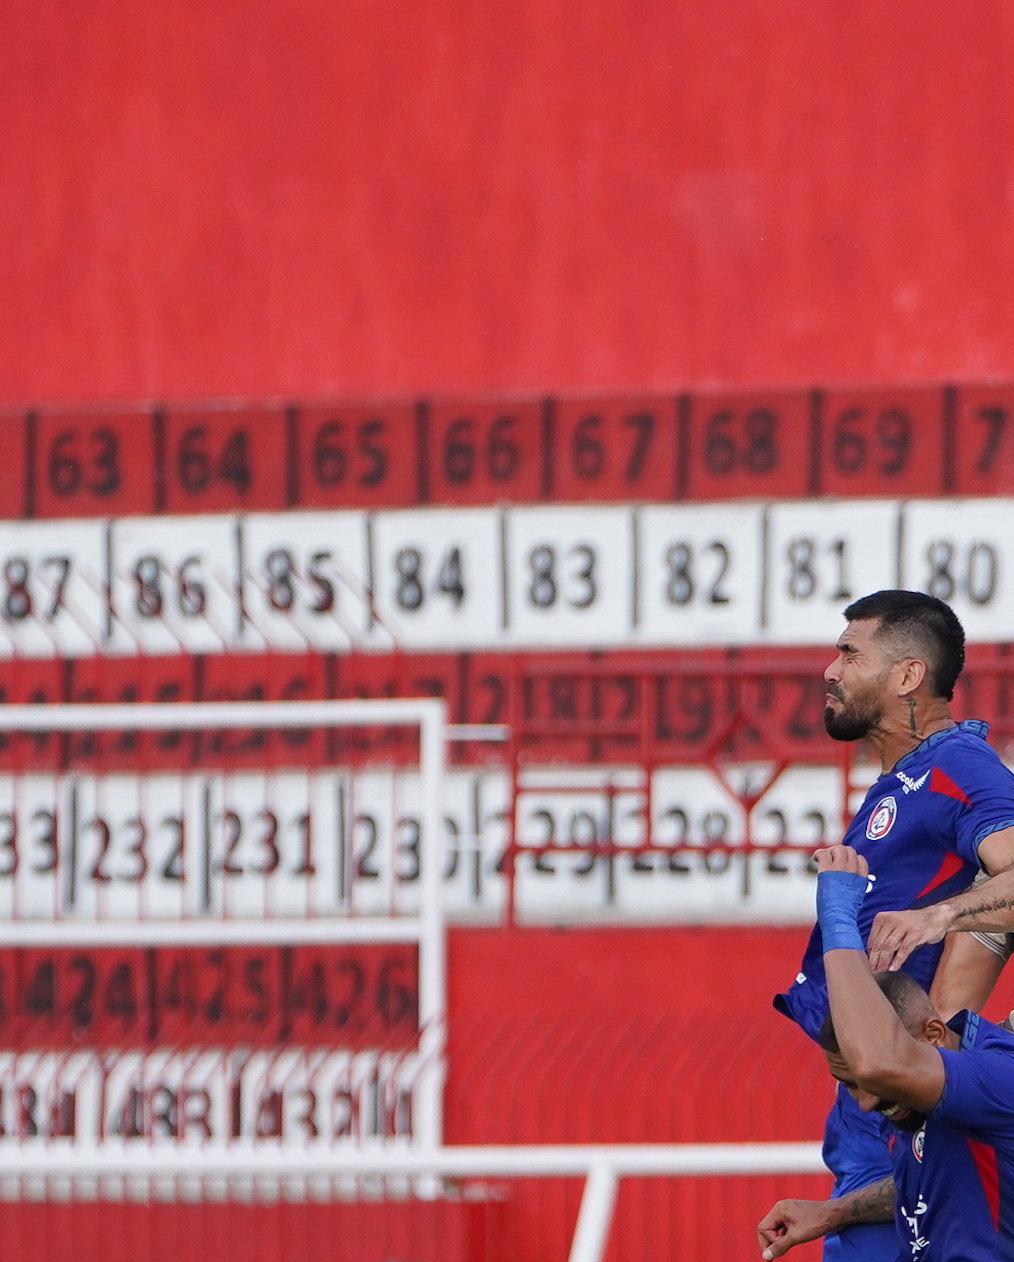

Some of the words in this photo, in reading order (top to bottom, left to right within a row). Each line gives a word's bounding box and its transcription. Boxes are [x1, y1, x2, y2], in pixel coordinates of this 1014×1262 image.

[48, 430, 121, 498] 63
[177, 426, 253, 497] 64
[312, 420, 389, 488] 65
[442, 415, 521, 487] 66
[570, 412, 656, 484] 67
[703, 407, 778, 477] 68
[833, 405, 911, 477] 69
[3, 555, 72, 621] 87
[134, 554, 206, 619] 86
[264, 548, 334, 615] 85
[395, 547, 466, 613] 84
[528, 544, 597, 611] 83
[664, 538, 731, 607] 82
[785, 539, 852, 603] 81
[926, 540, 999, 608] 80
[91, 816, 186, 882] 232
[222, 810, 316, 875] 231
